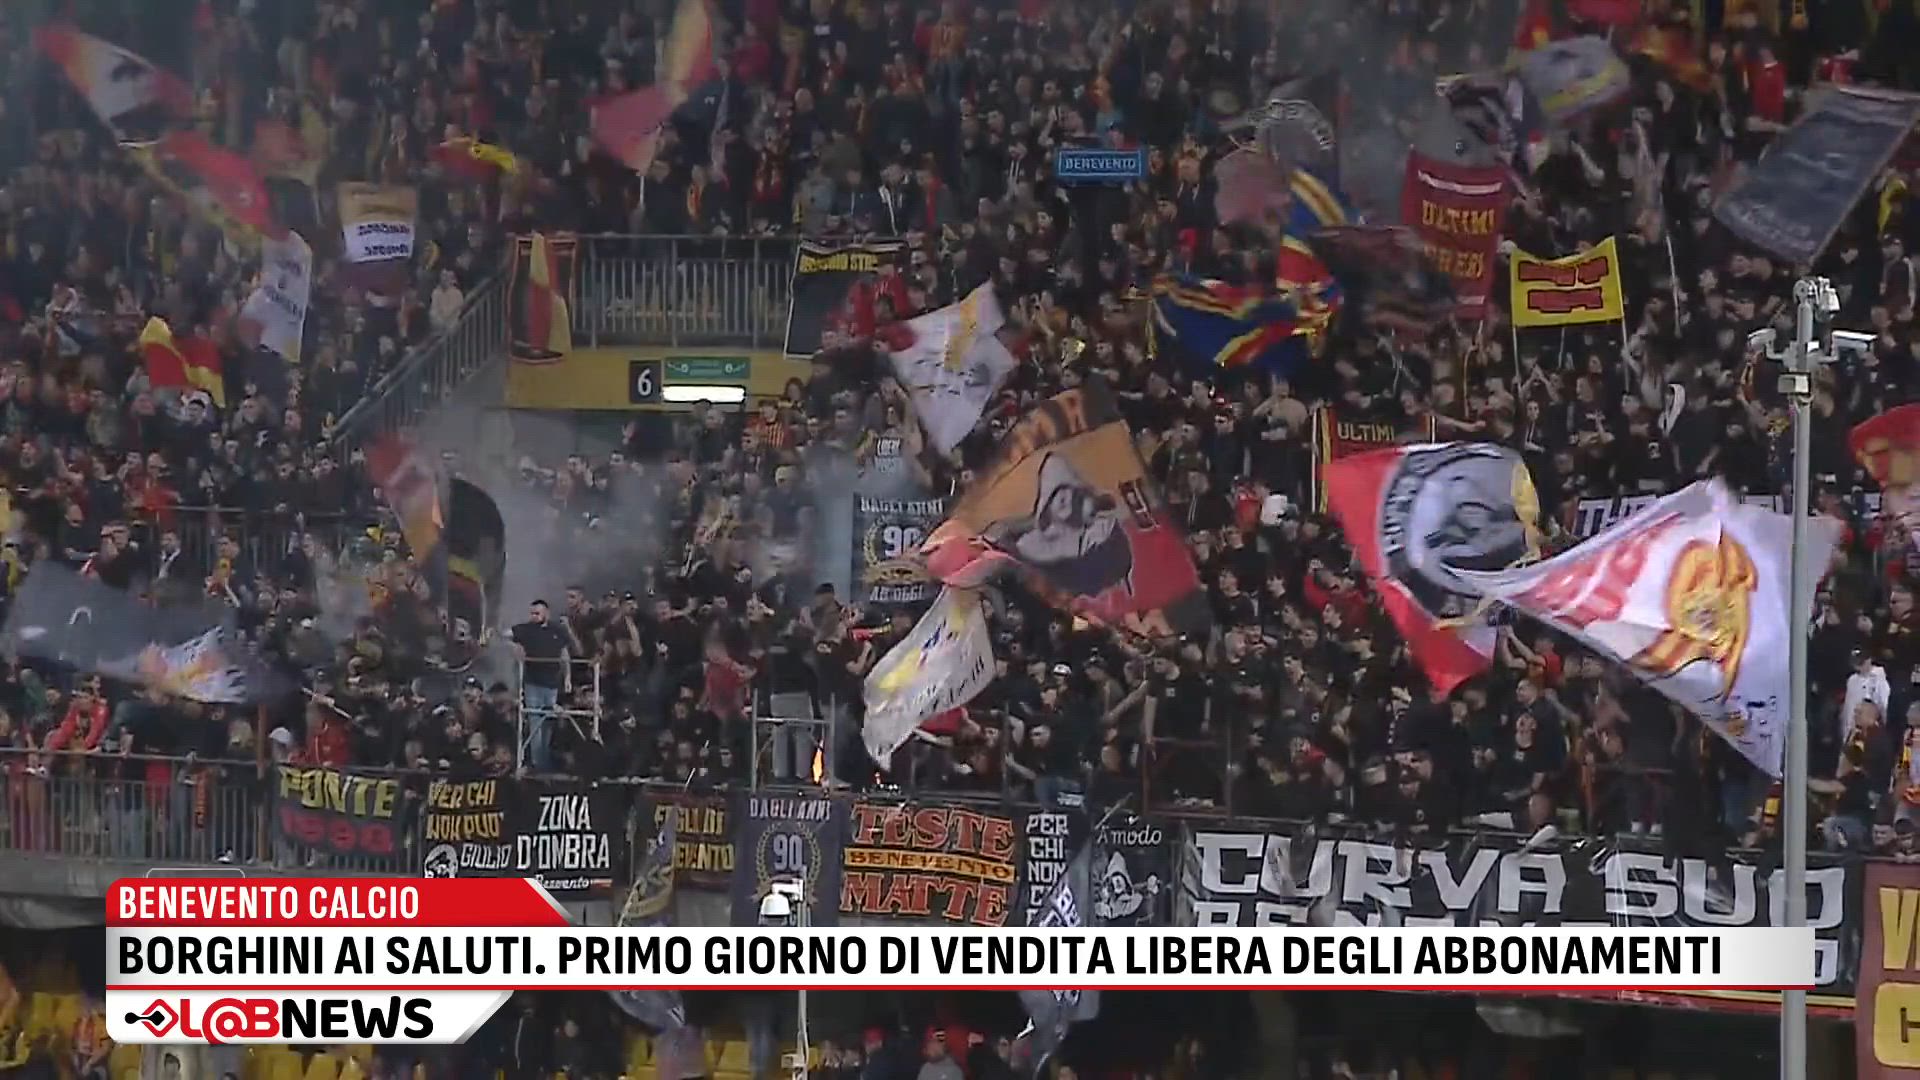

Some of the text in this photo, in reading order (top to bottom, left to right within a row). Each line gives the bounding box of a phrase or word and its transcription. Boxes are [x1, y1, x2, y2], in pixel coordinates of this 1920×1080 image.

[1065, 158, 1136, 169] BENEVENTO
[1422, 200, 1494, 234] ULTIMI
[637, 368, 652, 396] 6
[1338, 423, 1395, 441] ULTIMI
[467, 780, 497, 806] CHI
[537, 795, 592, 831] ZONA
[750, 799, 832, 821] DAGLI ANNI
[852, 803, 1015, 861] TESTE
[1026, 813, 1069, 835] PER
[1112, 824, 1162, 846] modo
[460, 843, 513, 869] GIULIO
[516, 833, 611, 870] D'OMBRA
[773, 833, 803, 871] 90
[1029, 837, 1064, 859] CHI
[850, 852, 1012, 879] BENEVENTO
[1195, 832, 1845, 928] CURVA SUD
[839, 871, 1009, 927] MATTE
